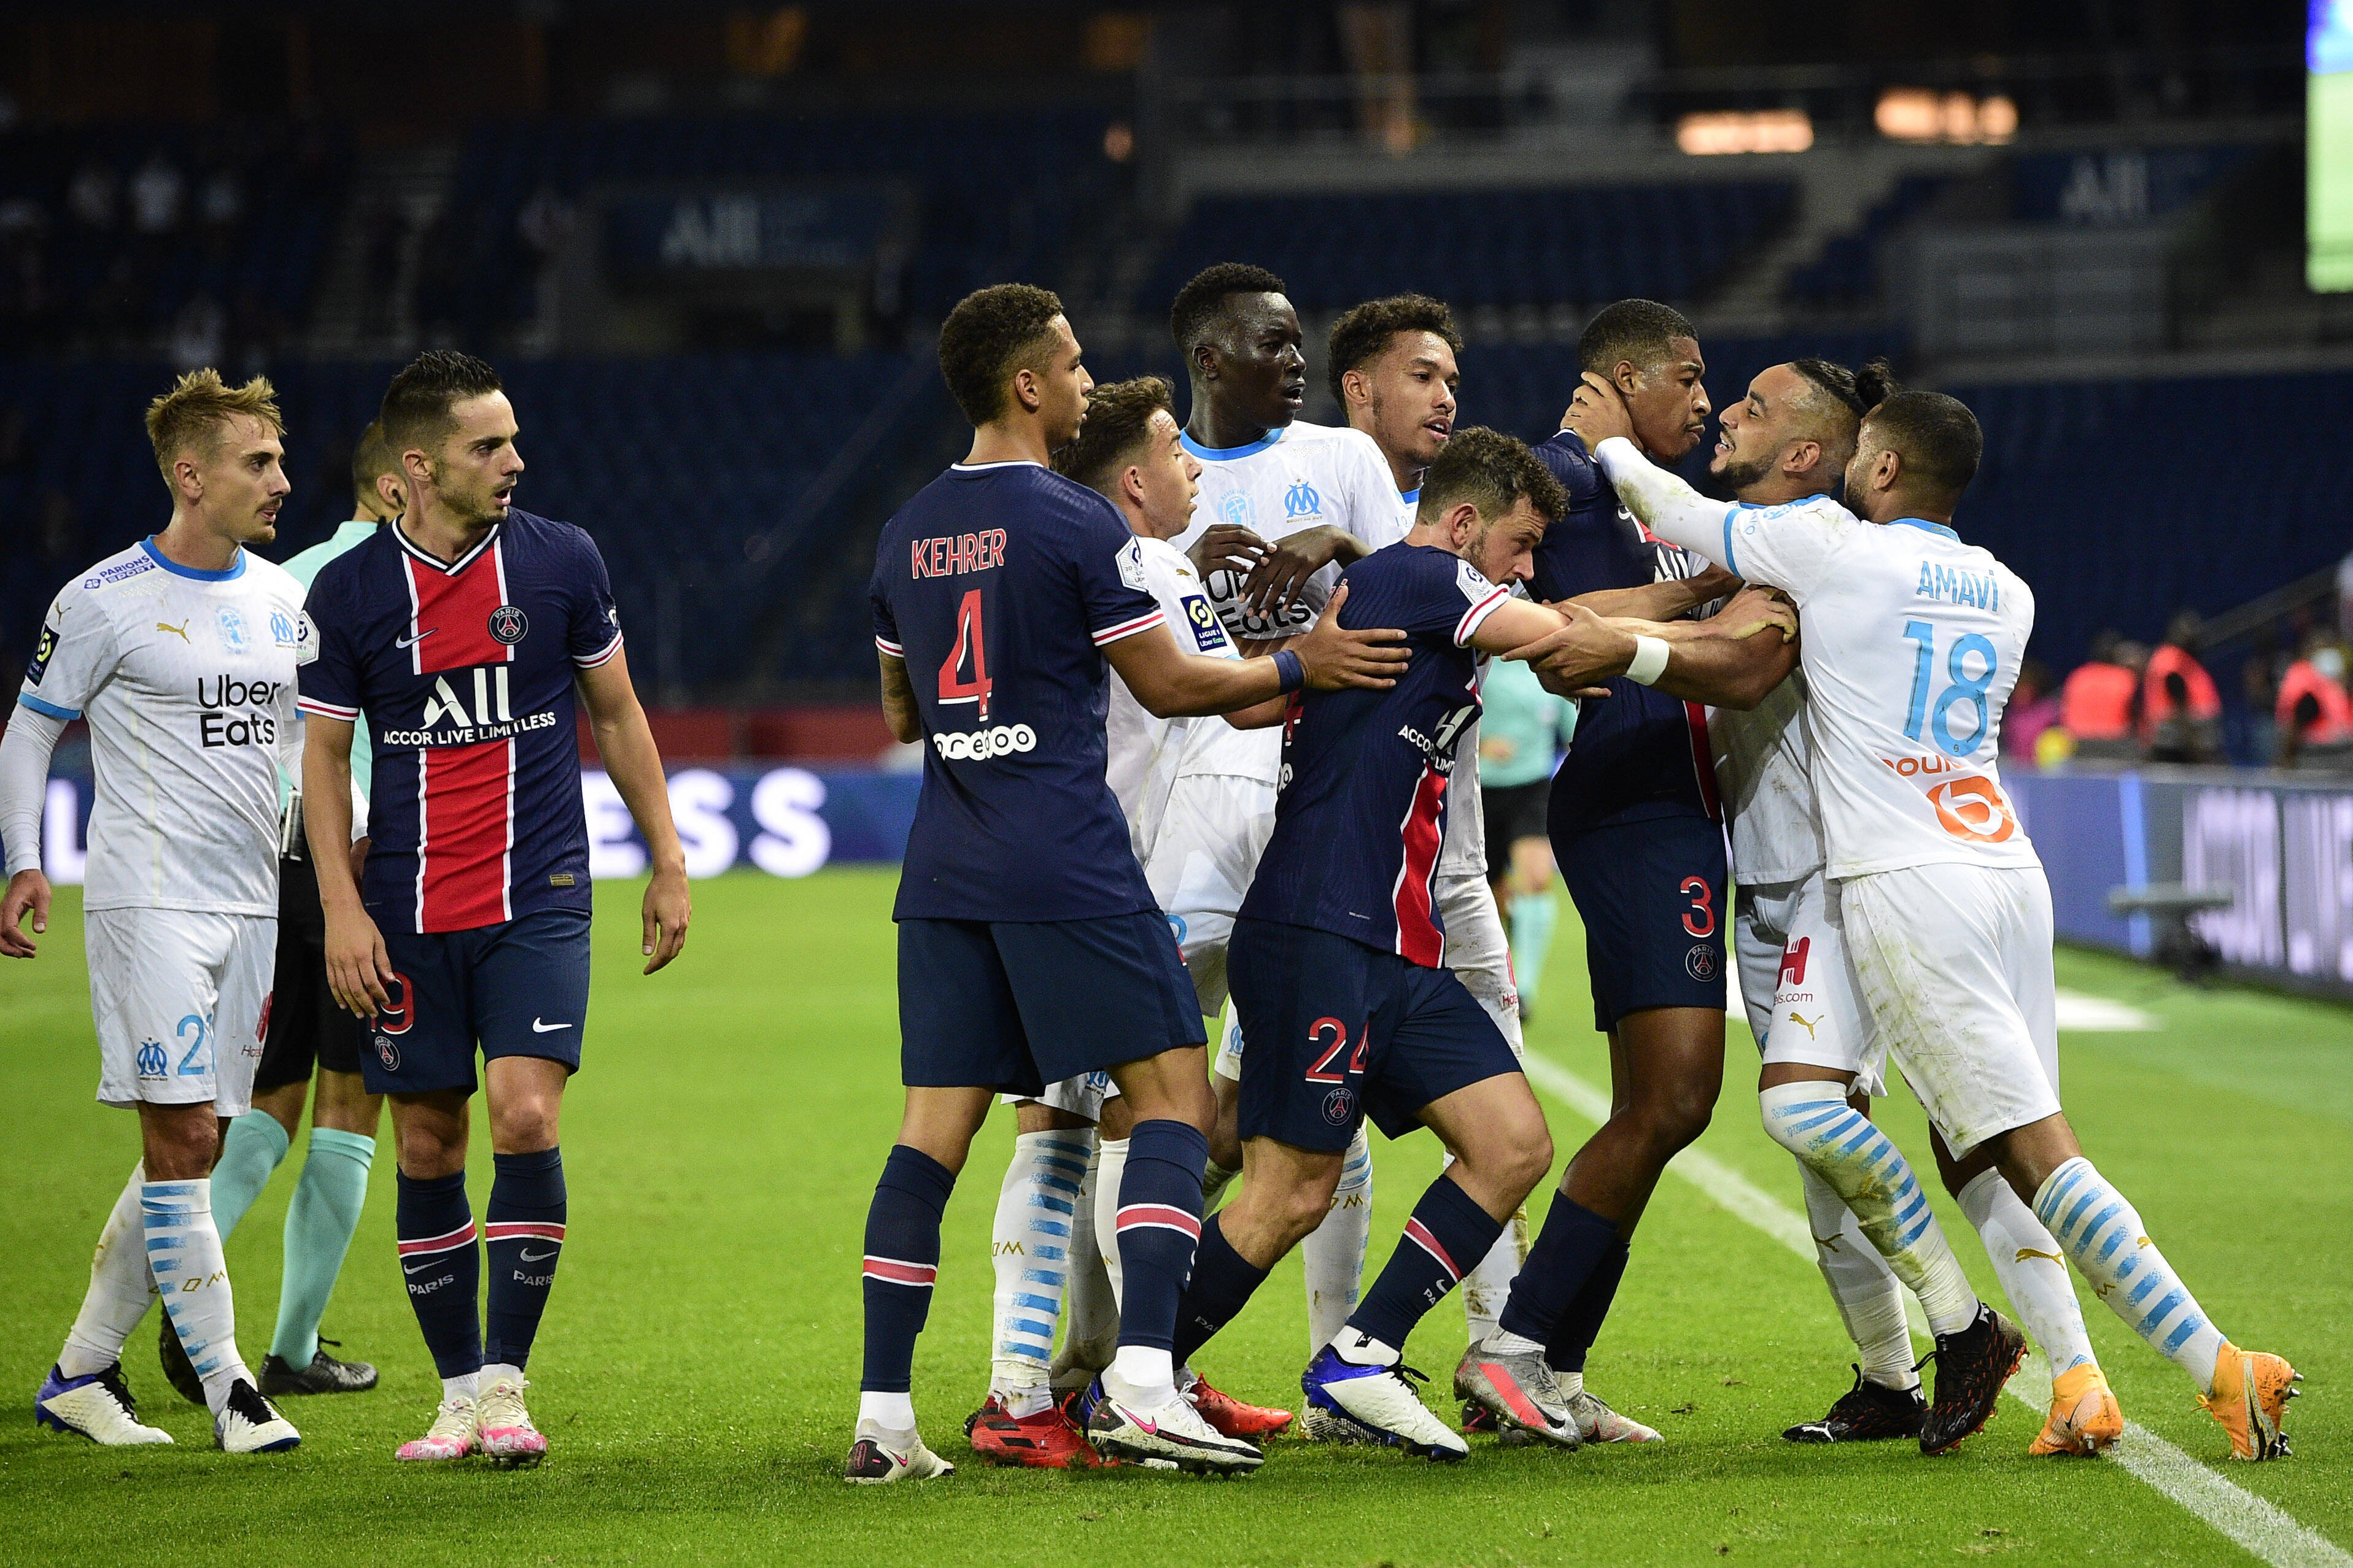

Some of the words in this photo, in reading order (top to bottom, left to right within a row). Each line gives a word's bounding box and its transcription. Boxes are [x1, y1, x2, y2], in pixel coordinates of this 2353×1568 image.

[99, 555, 150, 577] PARIONS
[912, 528, 1007, 579] KEHRER
[106, 563, 155, 582] SPORT
[494, 608, 520, 619] PARIS
[1199, 630, 1215, 639] LIGUE
[938, 589, 993, 722] 4
[198, 674, 281, 709] Uber
[1903, 620, 1997, 757] 18
[201, 714, 274, 747] Eats
[384, 730, 433, 745] ACCOR
[438, 729, 475, 744] LIVE
[479, 712, 556, 740] LIMITLESS
[1680, 876, 1715, 938] 3
[1692, 946, 1713, 956] PARIS
[1330, 1090, 1351, 1100] PARIS
[409, 1274, 454, 1295] PARIS
